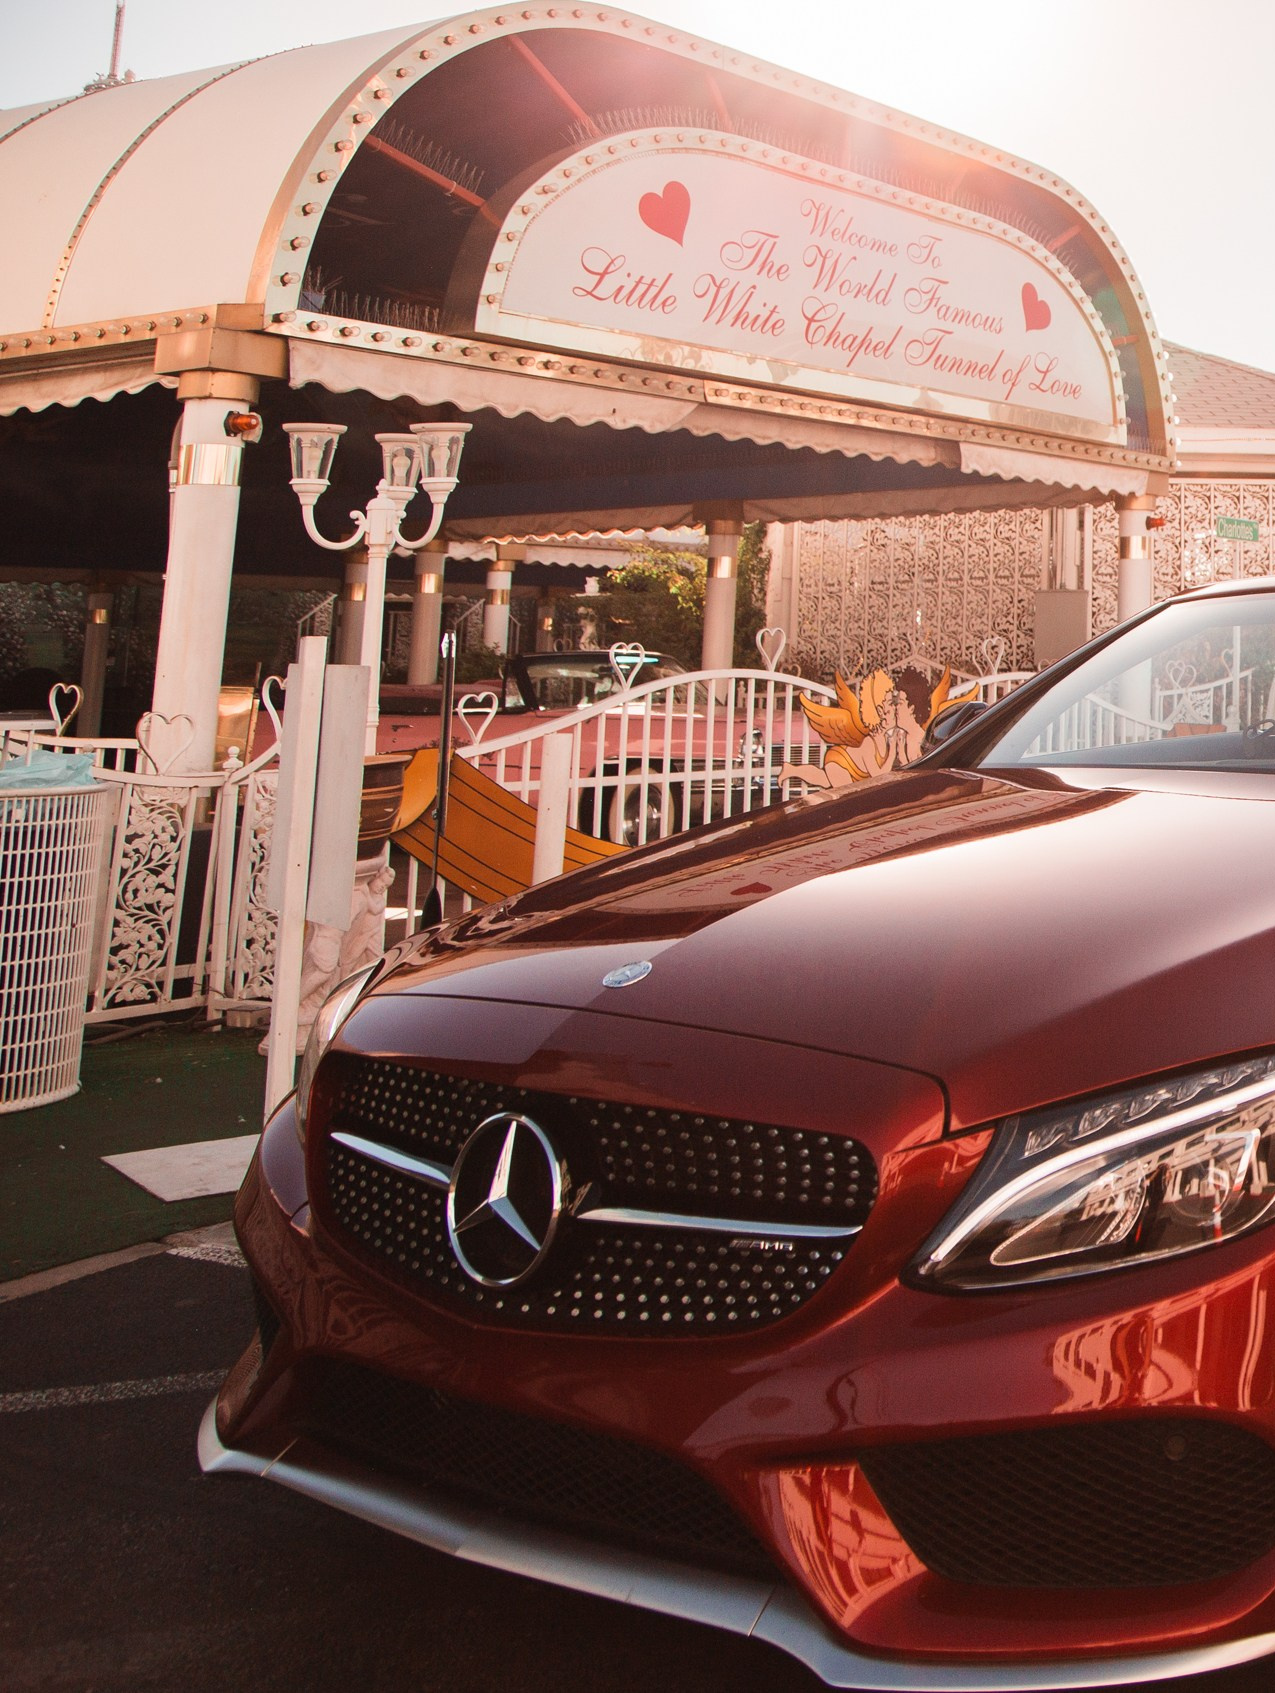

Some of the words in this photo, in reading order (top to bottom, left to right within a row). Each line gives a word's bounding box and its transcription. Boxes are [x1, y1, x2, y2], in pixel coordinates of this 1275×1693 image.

[800, 198, 898, 257] Welcome
[906, 234, 943, 269] To
[572, 246, 678, 315] Little
[693, 273, 786, 337] White
[801, 295, 904, 367] Chapel
[904, 327, 1004, 382] Tunnel
[1001, 353, 1032, 400] of
[1028, 352, 1082, 399] Love
[720, 229, 791, 282] The
[802, 244, 897, 306] World
[903, 277, 1004, 334] Famous
[751, 1240, 793, 1251] AMG
